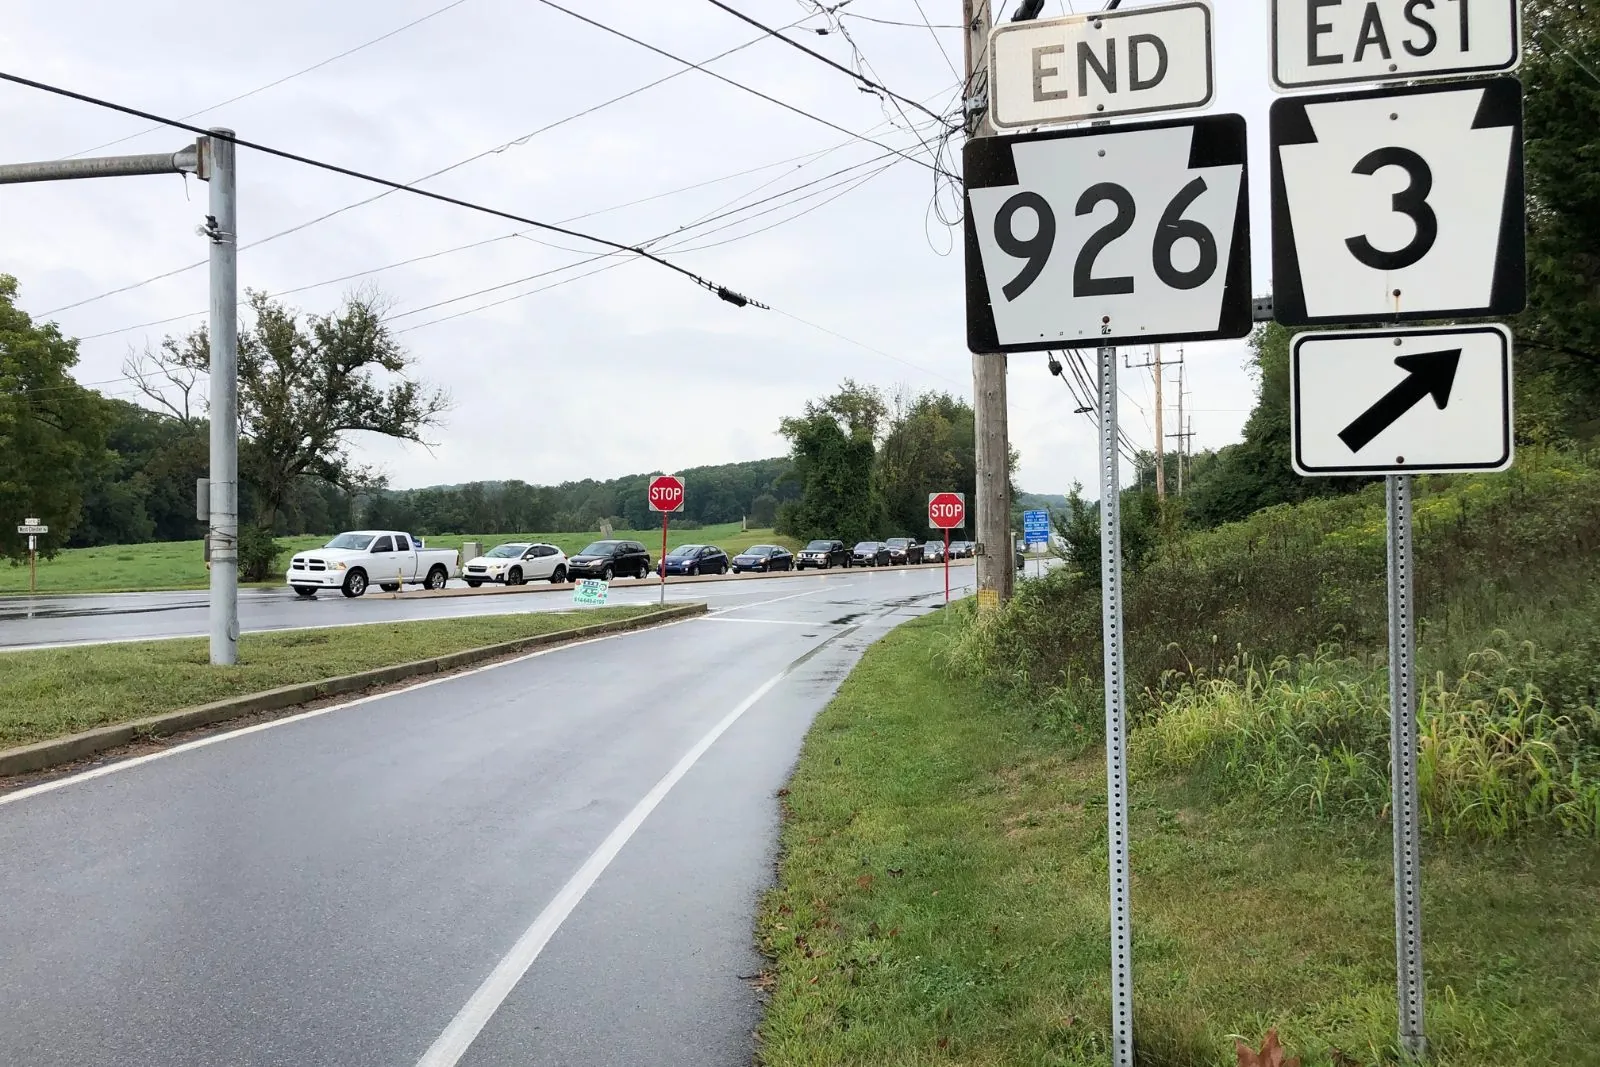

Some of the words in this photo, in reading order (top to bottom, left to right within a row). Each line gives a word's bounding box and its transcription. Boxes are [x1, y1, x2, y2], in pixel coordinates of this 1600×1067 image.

[1307, 0, 1469, 66] EAST
[1032, 34, 1168, 102] END
[993, 176, 1217, 302] 926
[1344, 146, 1438, 270] 3
[651, 487, 681, 500] STOP
[931, 504, 962, 517] STOP
